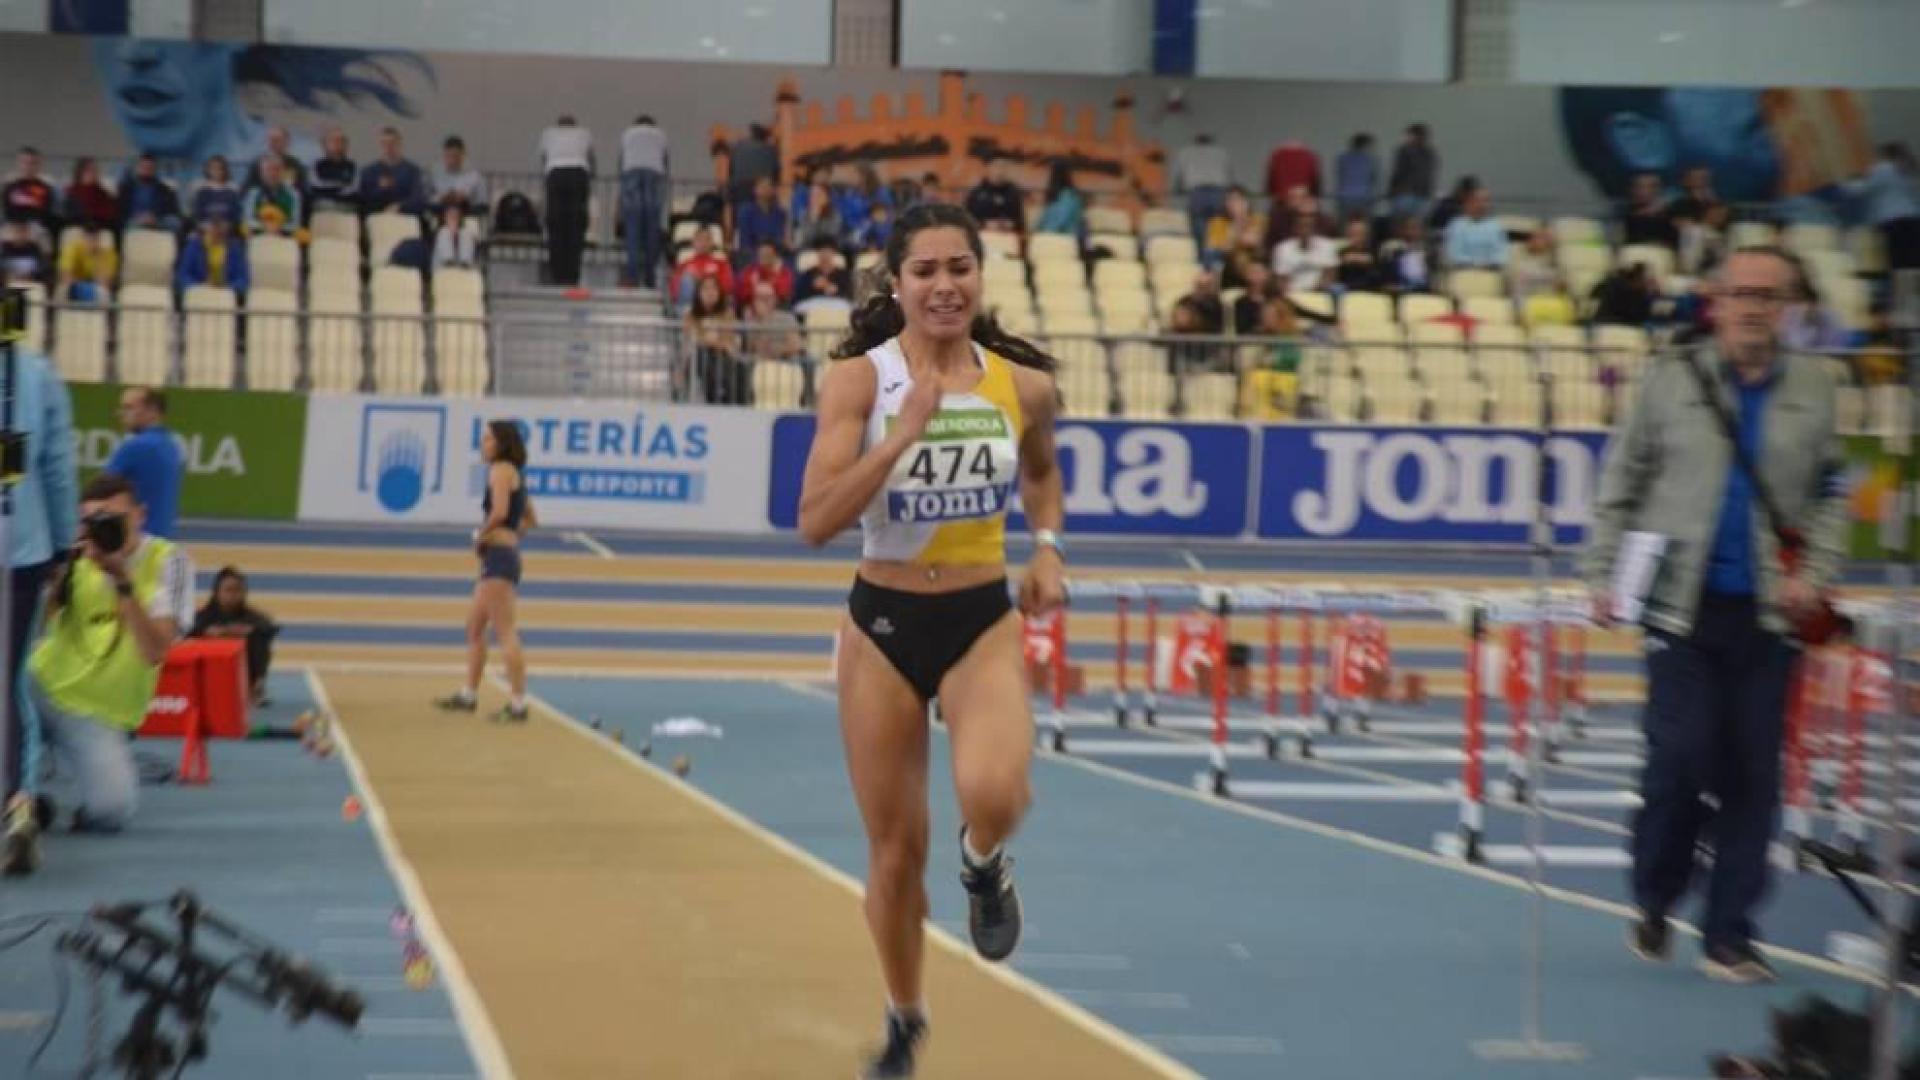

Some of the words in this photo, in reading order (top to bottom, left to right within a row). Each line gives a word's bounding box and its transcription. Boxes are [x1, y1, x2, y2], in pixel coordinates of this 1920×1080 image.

[908, 442, 997, 486] 474
[1291, 431, 1599, 535] Jom
[577, 476, 681, 497] DEPORTE
